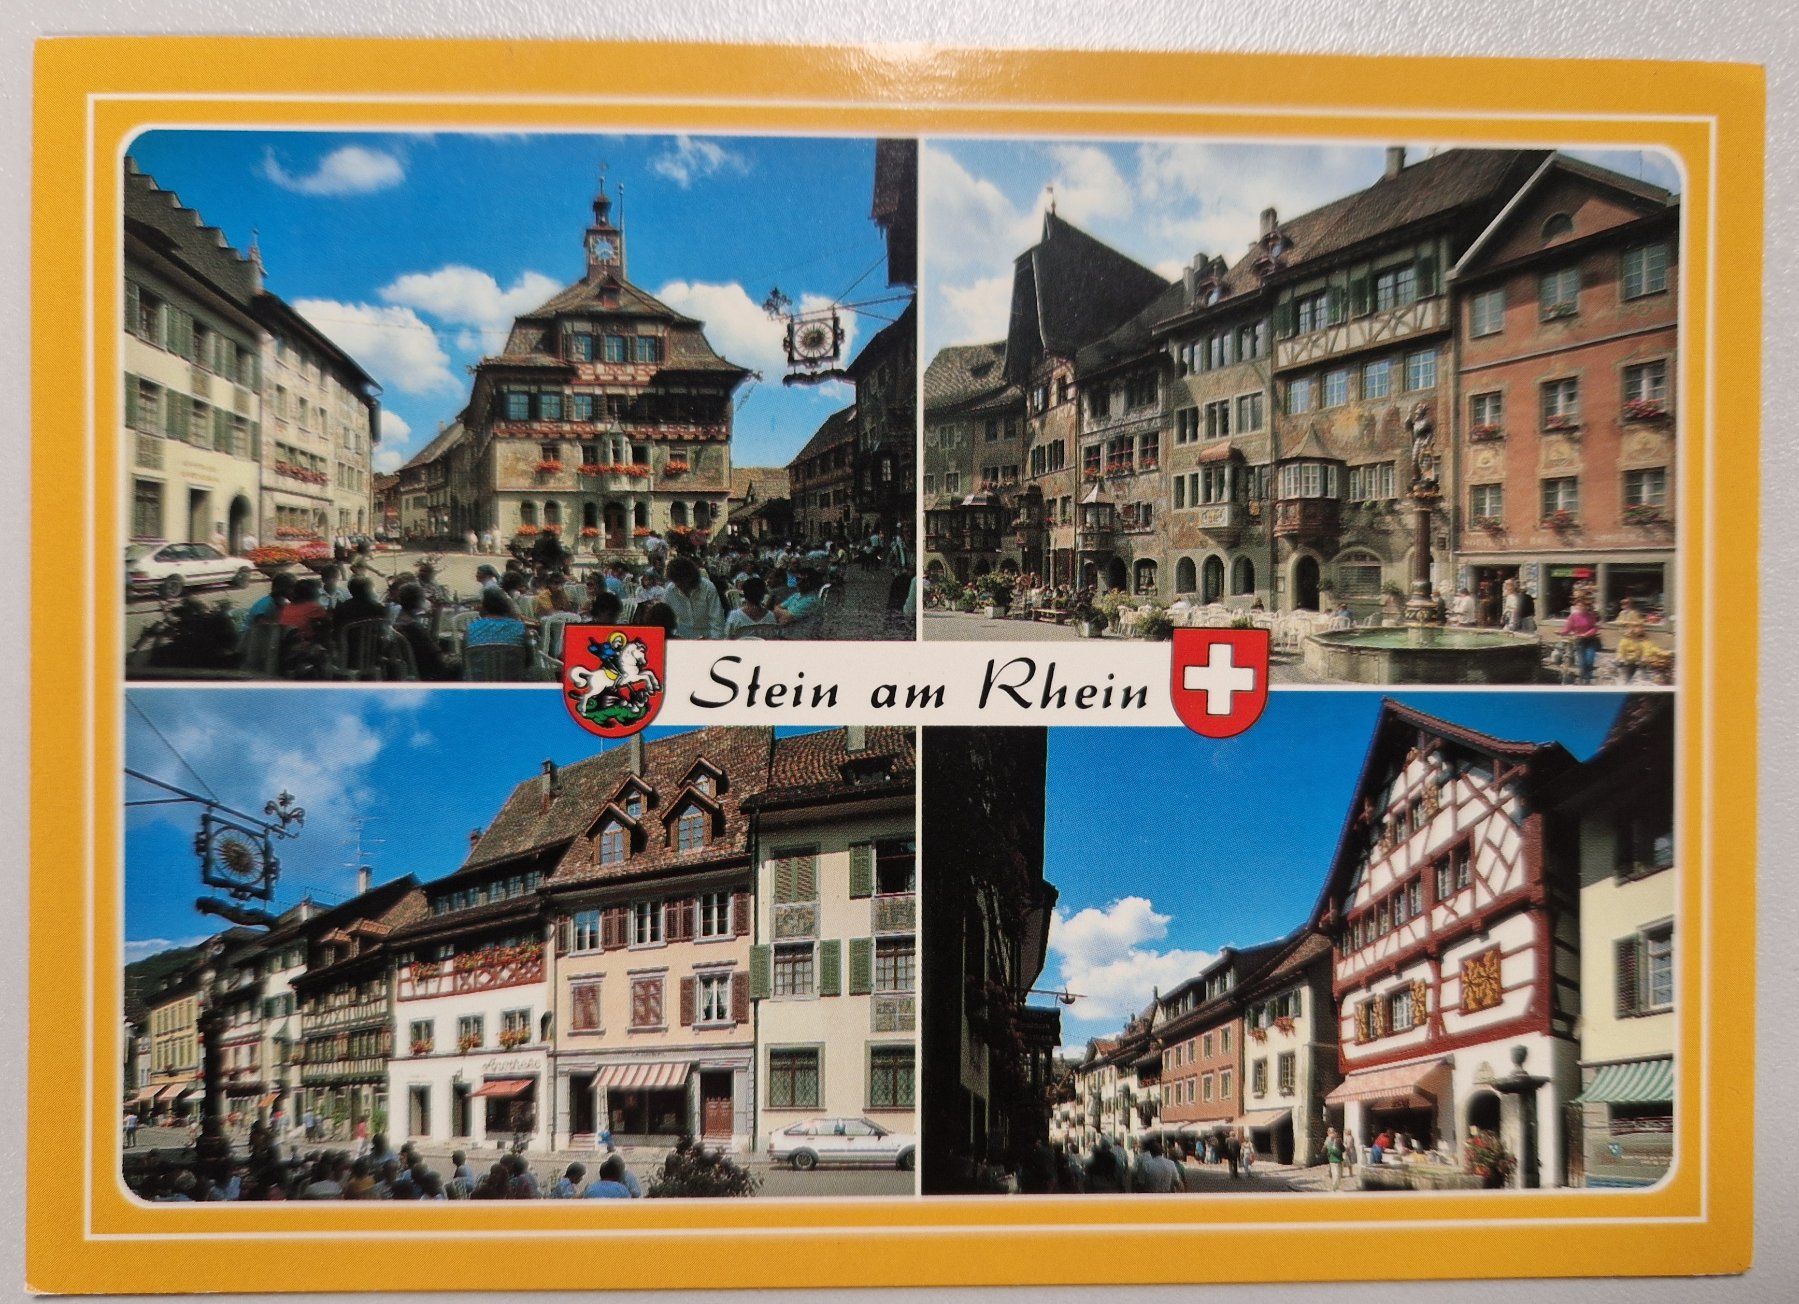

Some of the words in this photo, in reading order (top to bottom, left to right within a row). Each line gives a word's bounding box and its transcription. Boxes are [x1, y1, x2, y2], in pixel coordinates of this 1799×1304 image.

[689, 655, 839, 709] Stein
[870, 684, 945, 710] am
[977, 656, 1148, 710] Rhein
